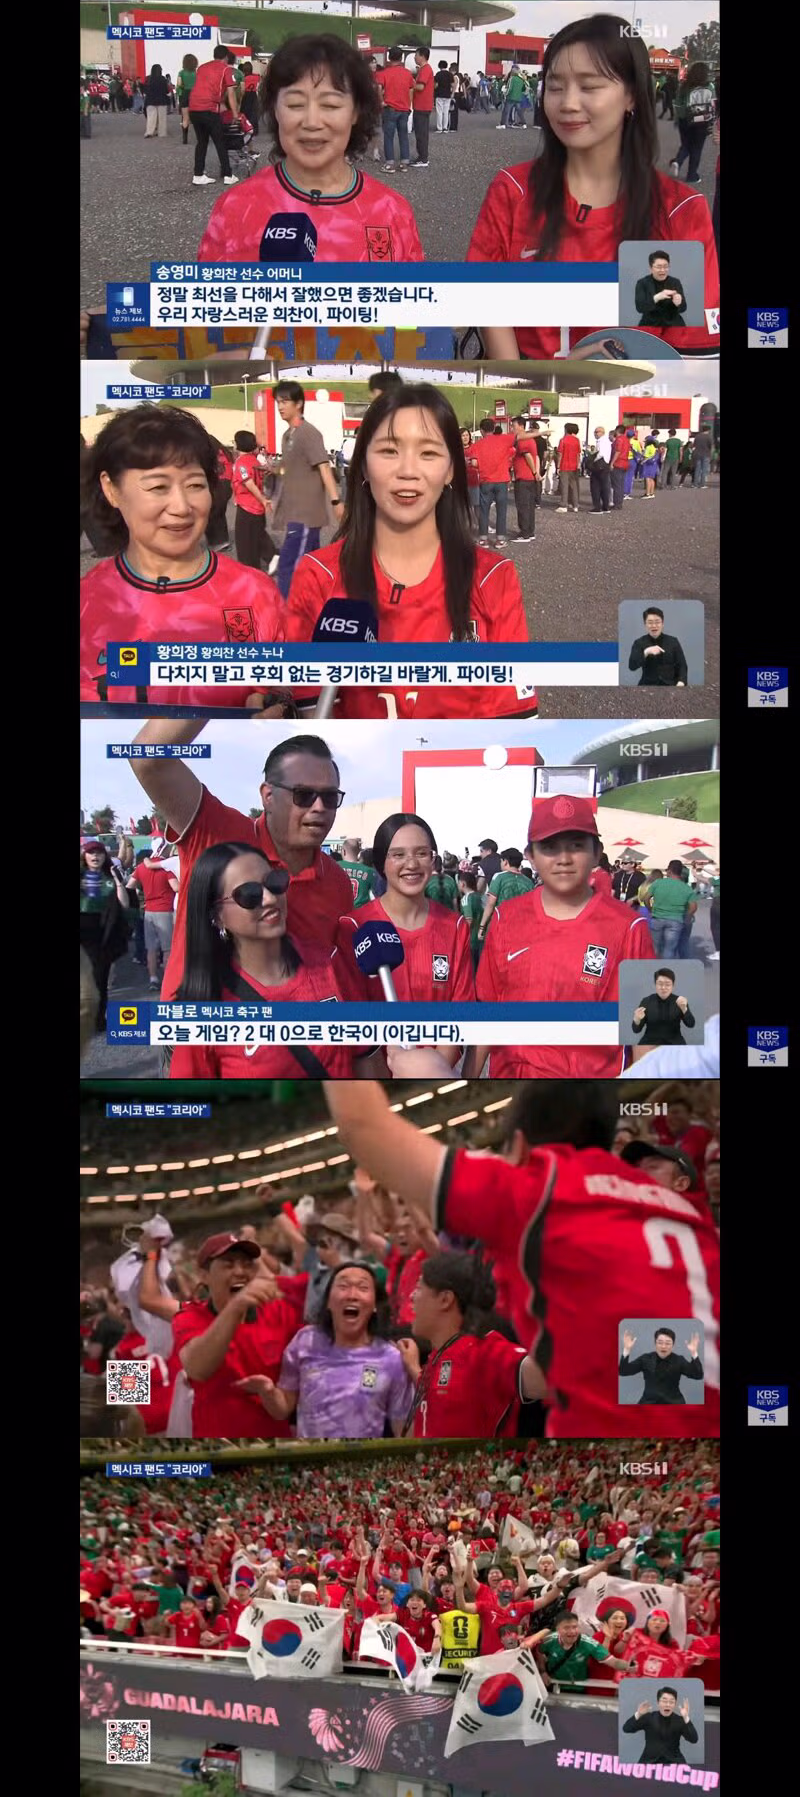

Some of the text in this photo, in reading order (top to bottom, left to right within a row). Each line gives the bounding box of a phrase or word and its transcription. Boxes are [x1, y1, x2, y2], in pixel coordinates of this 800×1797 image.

[264, 228, 298, 240] KBS
[320, 617, 360, 634] KBS
[354, 936, 372, 958] KBS
[376, 932, 400, 943] KBS
[642, 1218, 720, 1390] 7
[124, 1688, 280, 1726] GUADALAJARA
